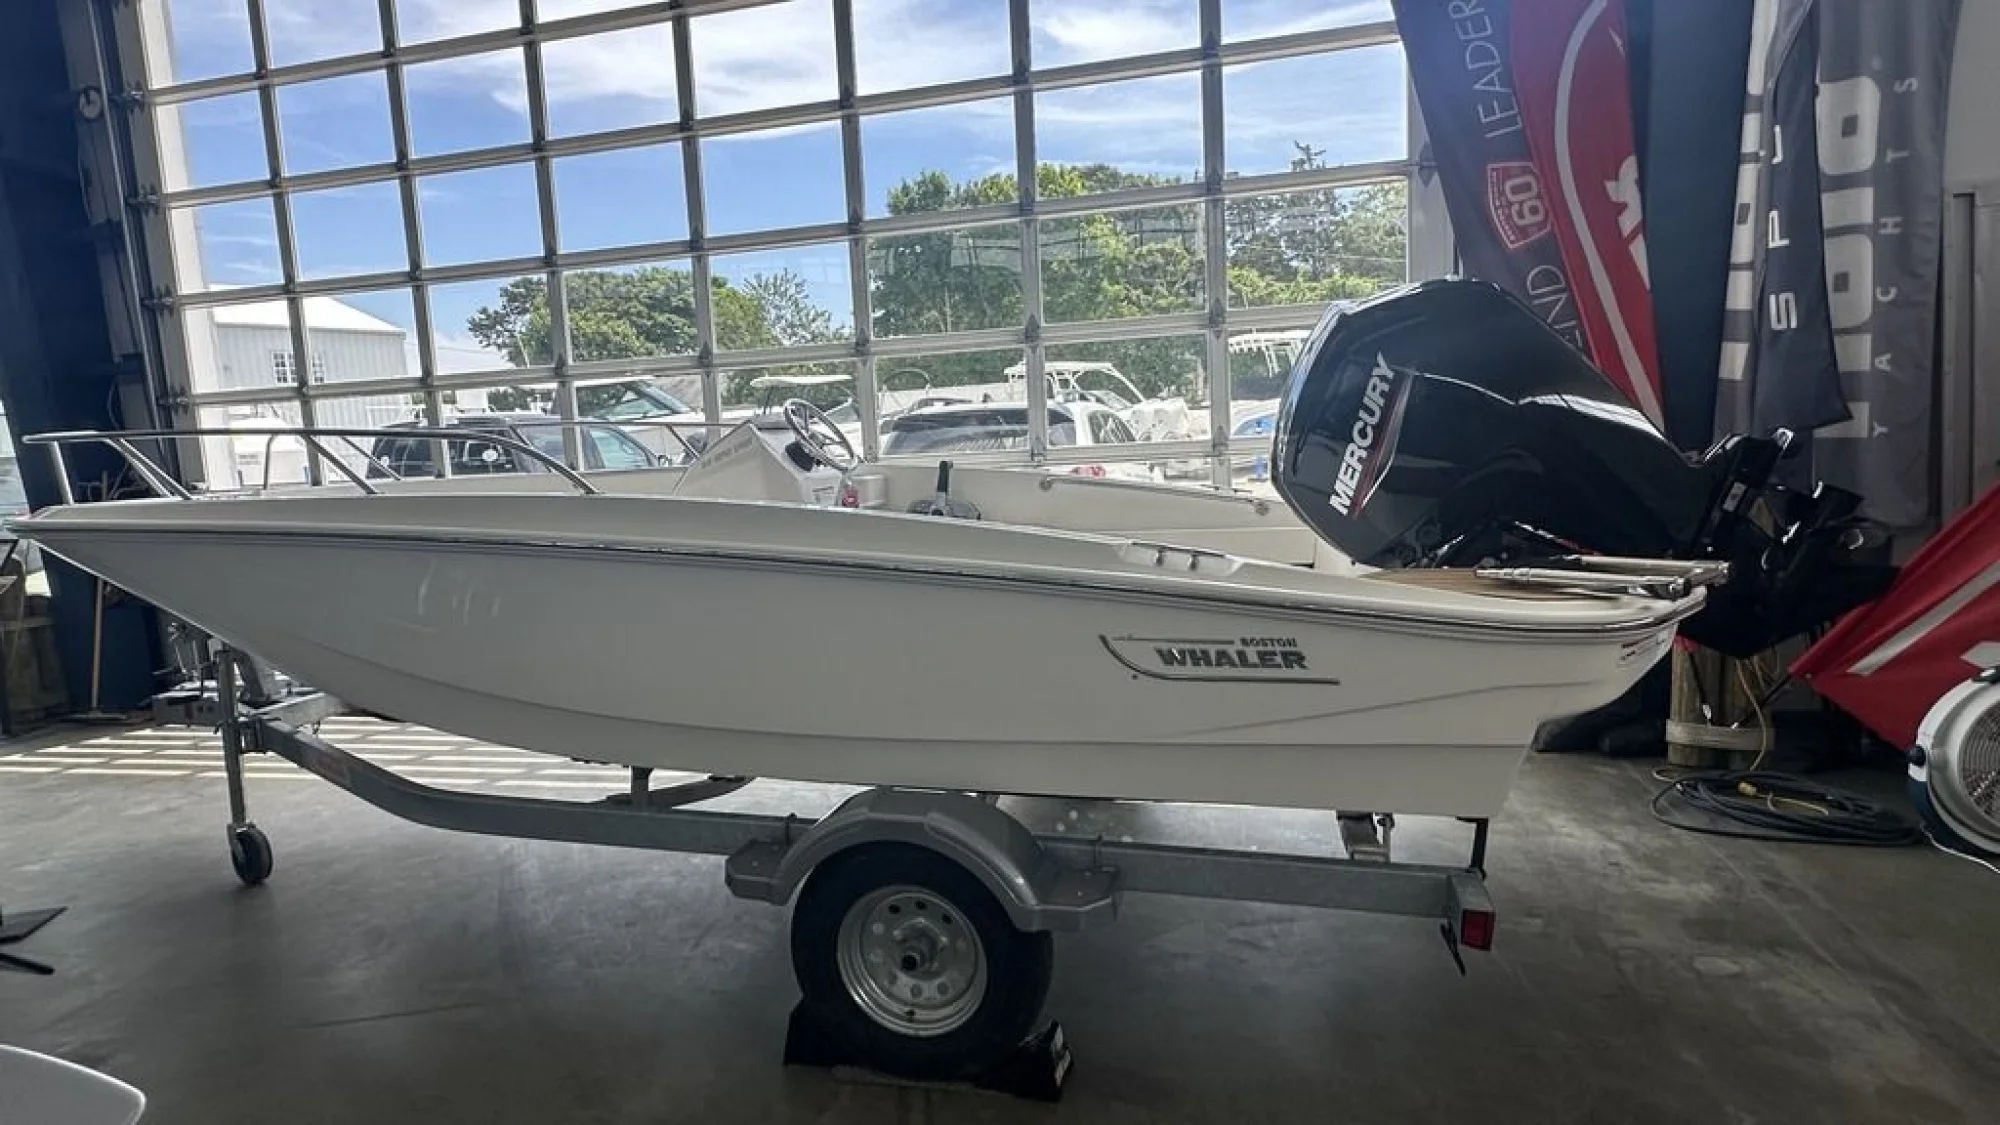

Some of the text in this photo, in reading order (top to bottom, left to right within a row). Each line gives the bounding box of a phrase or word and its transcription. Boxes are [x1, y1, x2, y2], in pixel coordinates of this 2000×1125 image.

[1504, 175, 1545, 226] 60
[1873, 77, 1918, 438] YACHTS
[1329, 351, 1394, 516] MERCURY
[1154, 647, 1308, 669] WHALER
[1240, 637, 1297, 648] BOSTON
